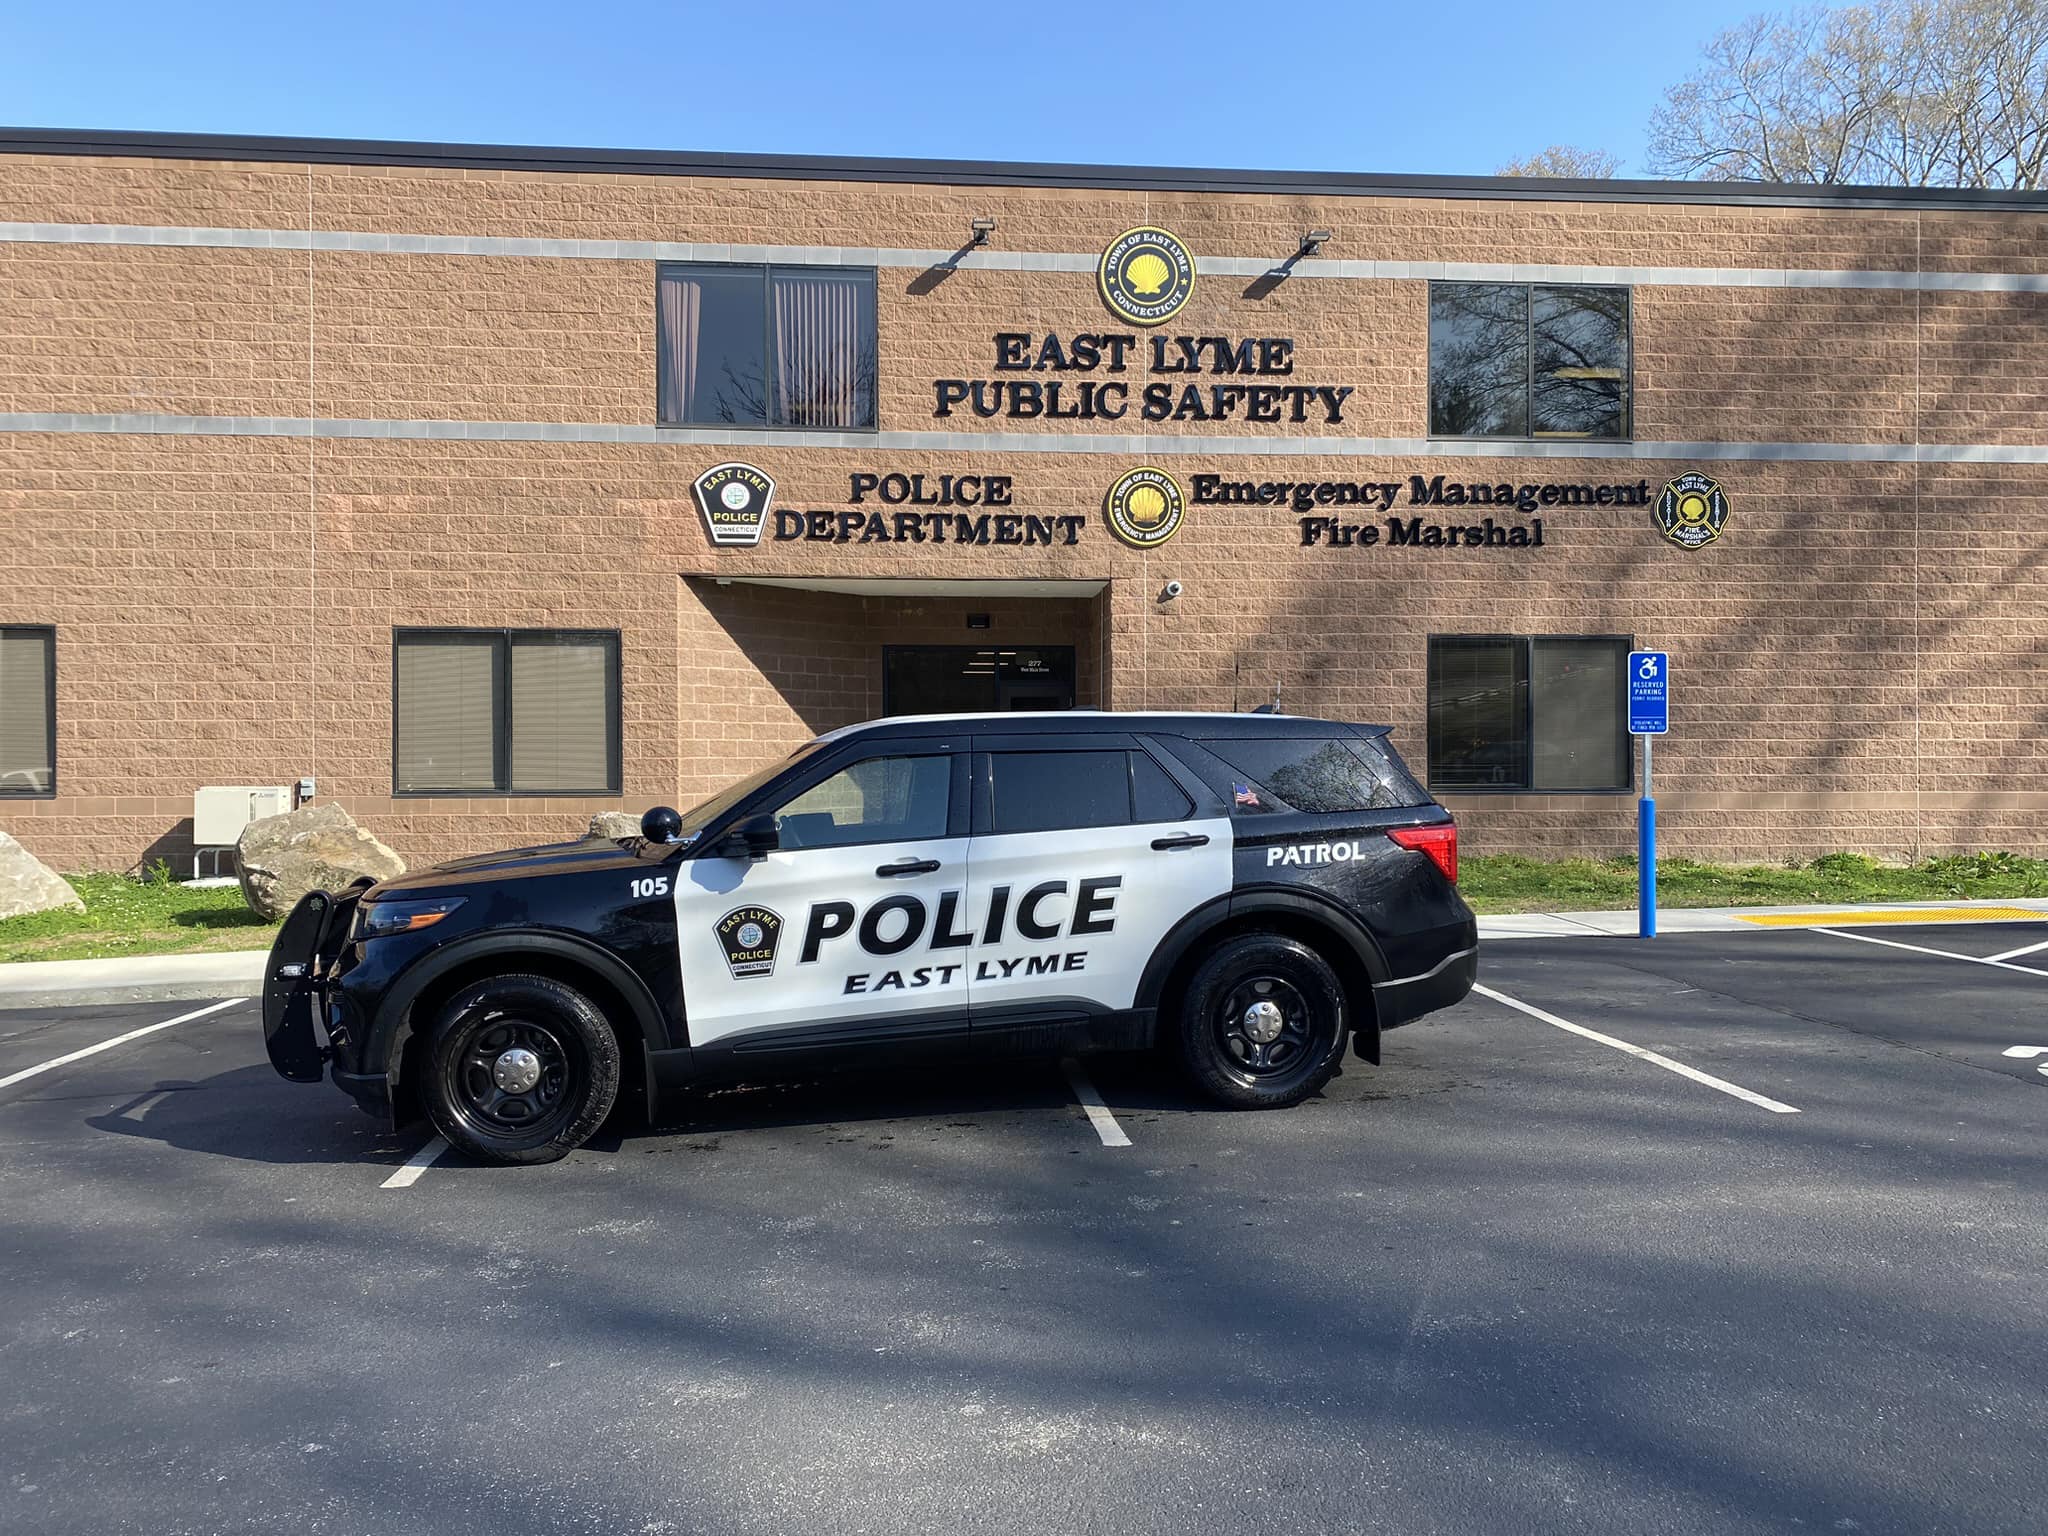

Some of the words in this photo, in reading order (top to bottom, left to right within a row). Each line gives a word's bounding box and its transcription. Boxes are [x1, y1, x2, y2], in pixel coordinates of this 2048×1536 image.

[1108, 242, 1129, 271] TOWN
[1128, 233, 1141, 245] OF
[1143, 233, 1171, 247] EAST
[1169, 243, 1188, 272] LYME
[1113, 290, 1183, 316] CONNECTICUT
[996, 333, 1135, 372] EAST
[1150, 335, 1294, 375] LYME
[933, 379, 1128, 419] PUBLIC
[1142, 382, 1353, 423] SAFETY
[703, 469, 733, 491] EAST
[736, 470, 767, 492] LYME
[848, 472, 1012, 506] POLICE
[1116, 478, 1133, 497] TOWN
[1132, 473, 1143, 482] OF
[1144, 472, 1164, 483] EAST
[1162, 480, 1178, 499] LYME
[1190, 474, 1402, 512] Emergency
[1408, 475, 1651, 512] Management
[1677, 481, 1692, 492] EAST
[1693, 482, 1710, 492] LYME
[713, 512, 758, 522] POLICE
[714, 525, 758, 533] CONNECTICUT
[773, 510, 1085, 545] DEPARTMENT
[1114, 507, 1144, 539] EMERGENCY
[1684, 526, 1701, 534] FIRE
[1301, 517, 1378, 547] Fire
[1386, 517, 1545, 547] Marshal
[1266, 841, 1366, 867] PATROL
[630, 876, 669, 898] 105
[720, 911, 746, 933] EAST
[750, 910, 778, 929] LYME
[799, 873, 1124, 964] POLICE
[731, 949, 772, 961] POLICE
[732, 961, 772, 971] CONNECTICUT
[842, 963, 961, 995] EAST
[974, 950, 1089, 981] LYME
